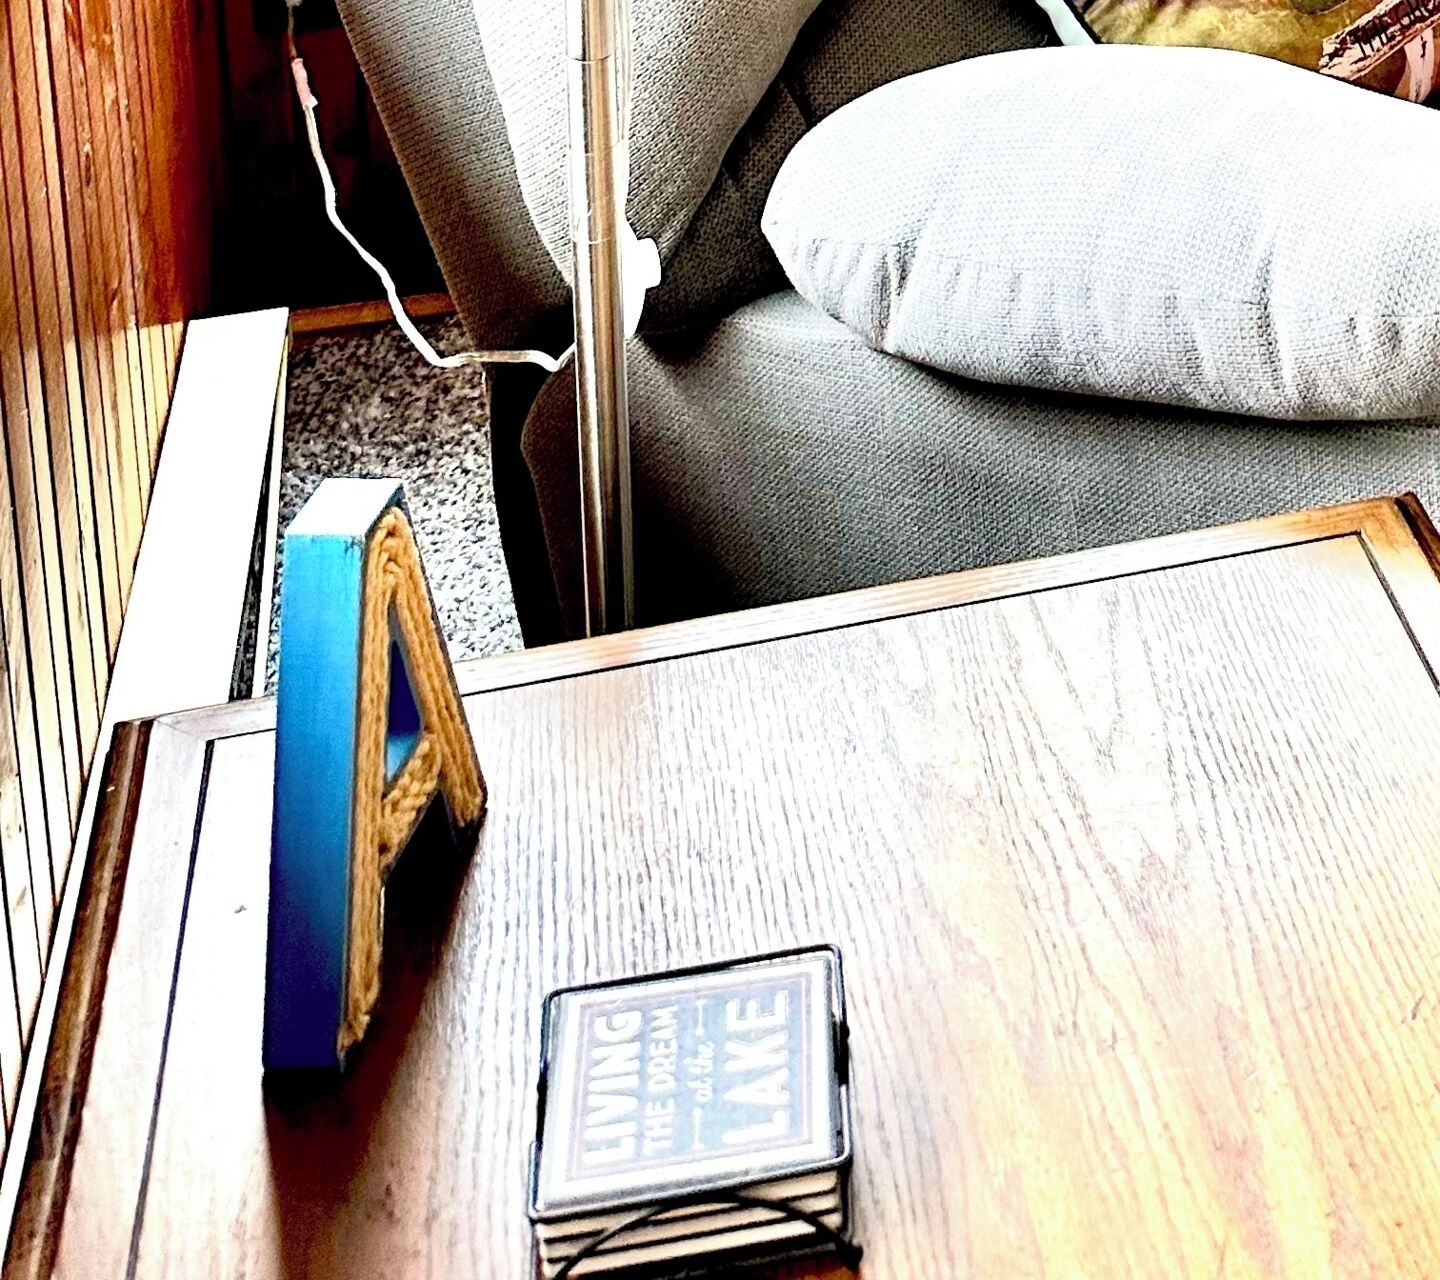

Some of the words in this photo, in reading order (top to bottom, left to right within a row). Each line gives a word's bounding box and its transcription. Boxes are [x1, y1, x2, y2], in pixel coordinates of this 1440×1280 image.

[582, 1010, 643, 1163] LIVING
[647, 1005, 679, 1094] DREAM
[683, 1040, 715, 1075] the
[722, 990, 790, 1144] LAKE
[643, 1097, 675, 1156] THE
[686, 1077, 713, 1103] at
